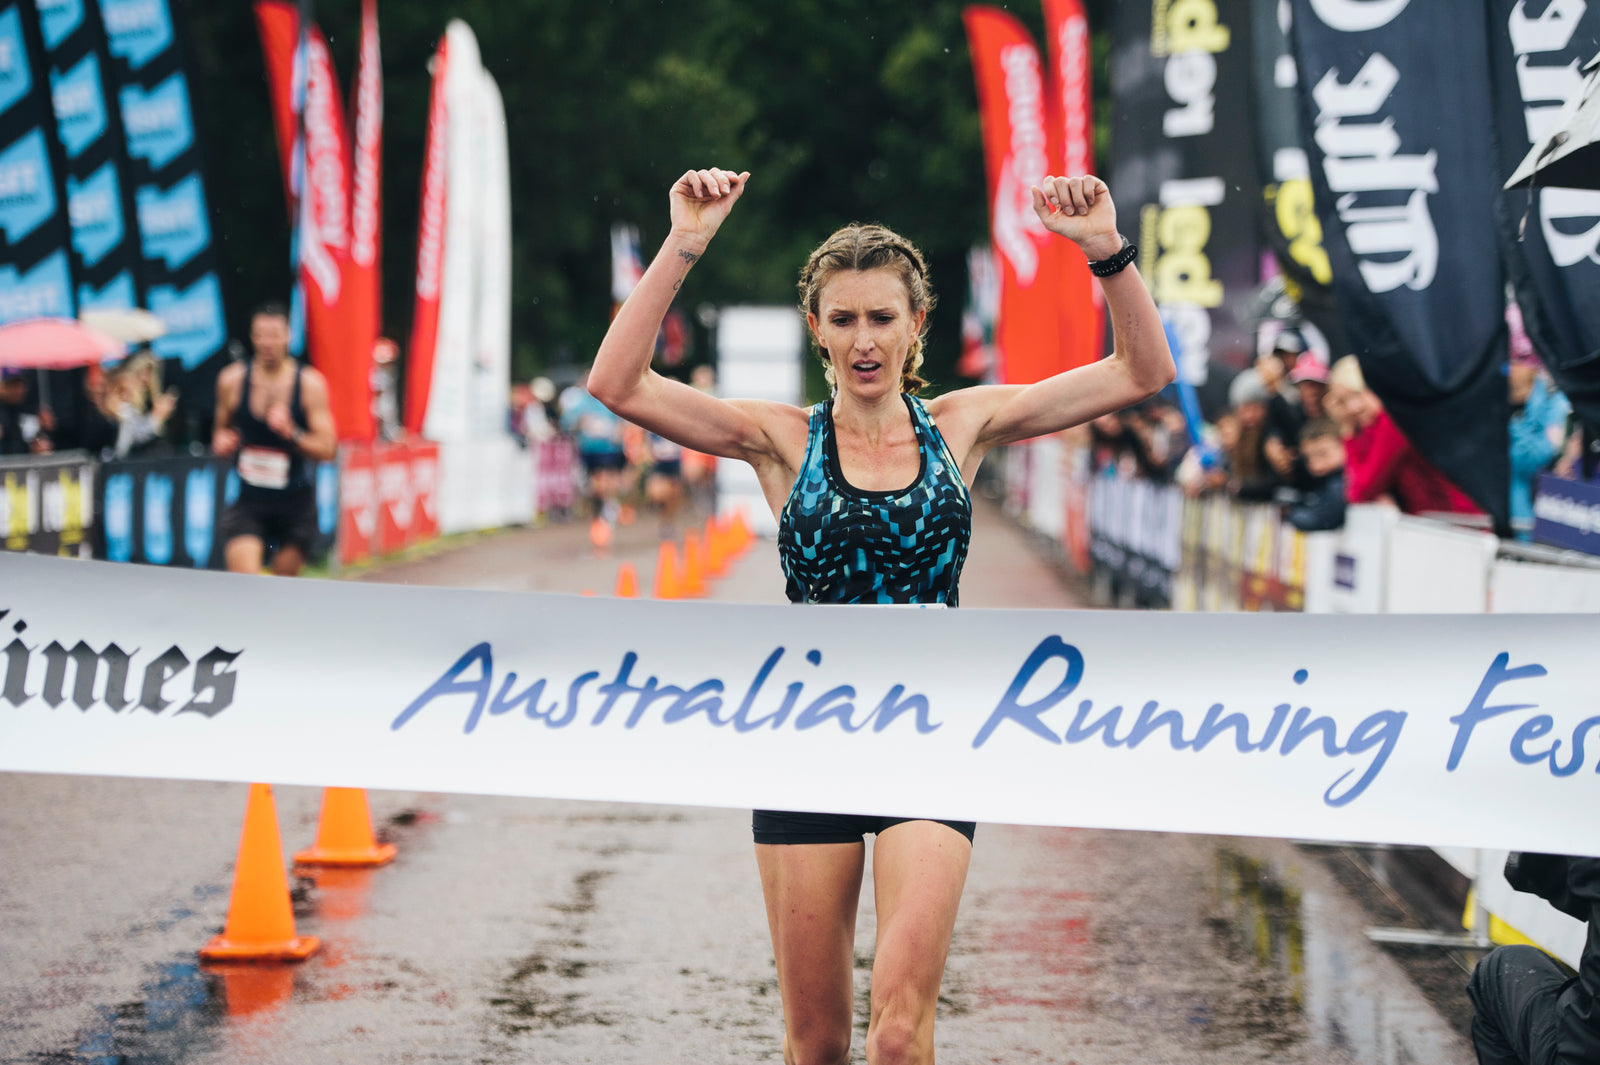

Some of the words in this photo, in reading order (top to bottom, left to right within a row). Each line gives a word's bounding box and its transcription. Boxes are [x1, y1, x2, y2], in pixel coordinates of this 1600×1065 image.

[0, 608, 245, 718] imes
[391, 641, 940, 734] Australian
[972, 634, 1409, 807] Running
[1446, 650, 1600, 778] Fes
